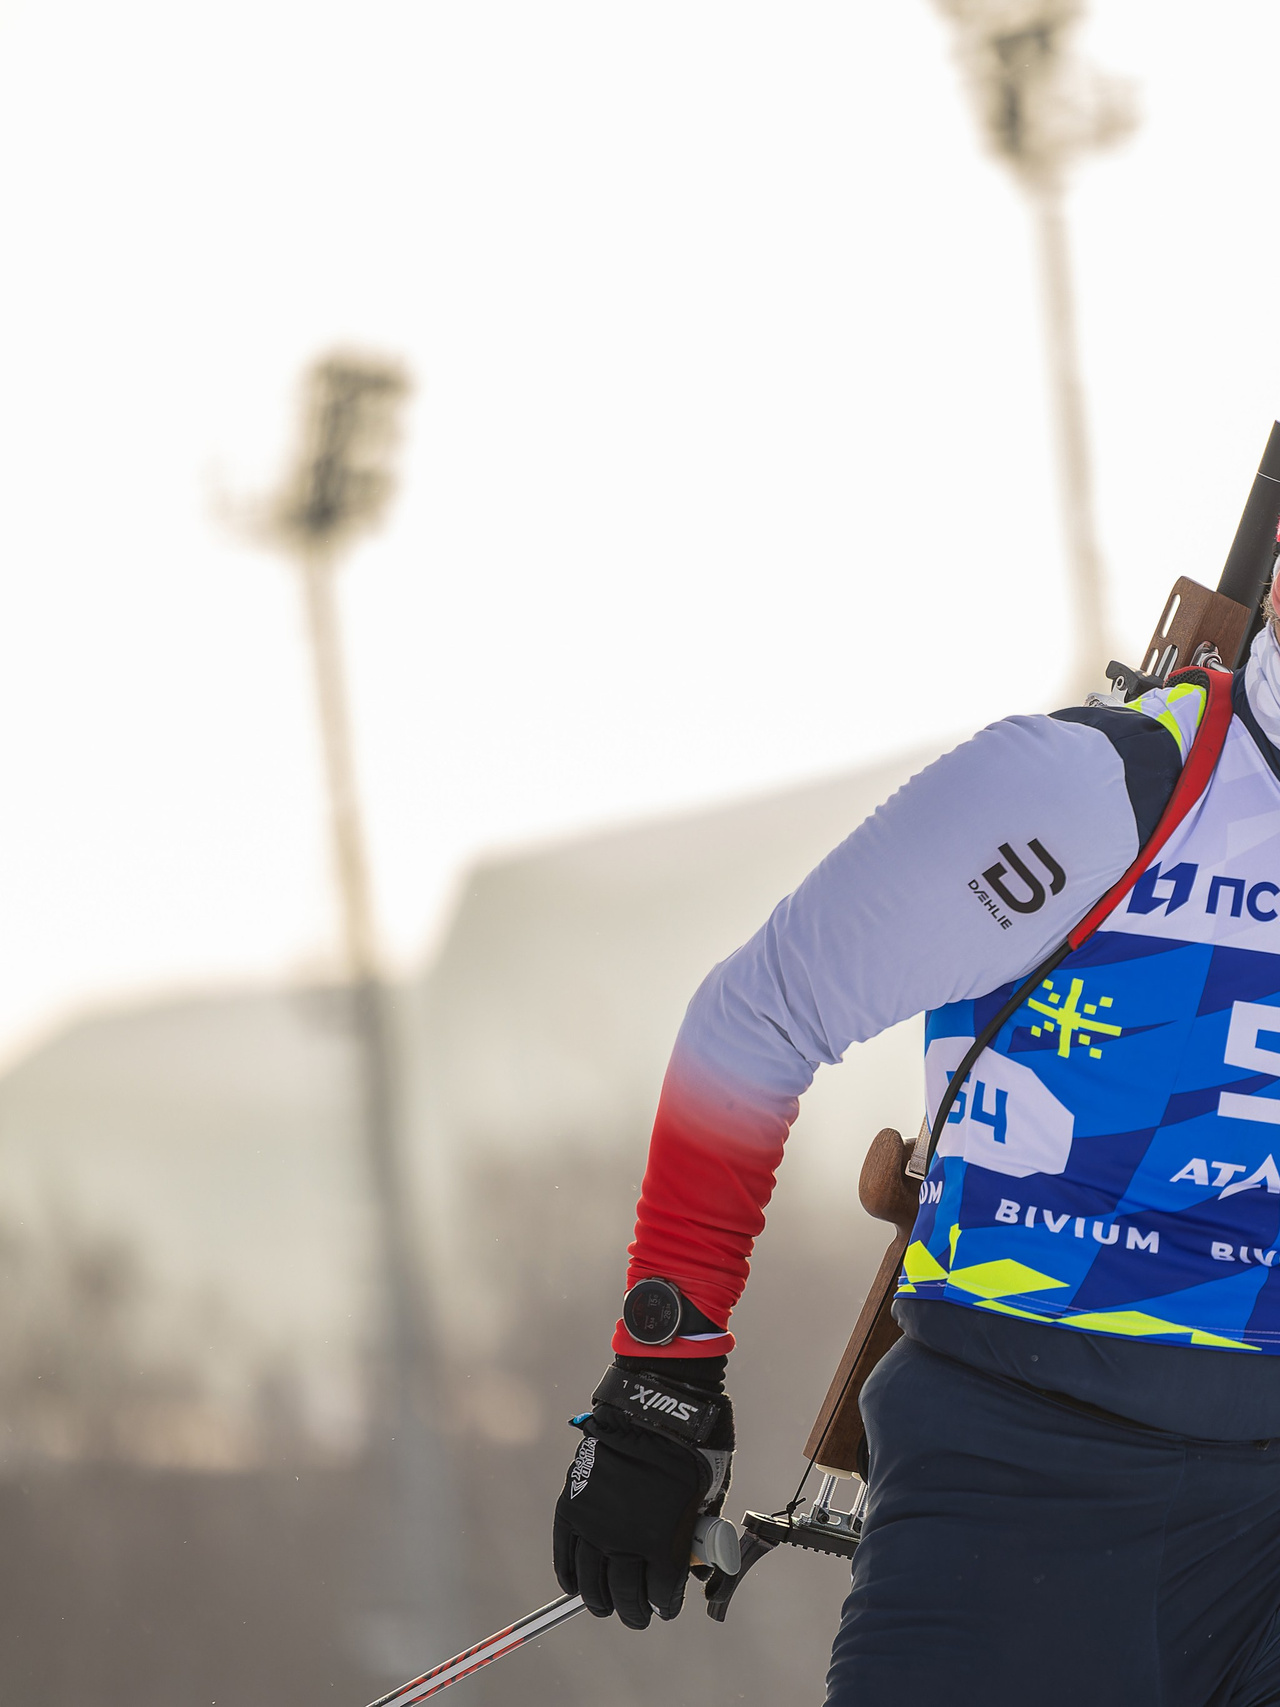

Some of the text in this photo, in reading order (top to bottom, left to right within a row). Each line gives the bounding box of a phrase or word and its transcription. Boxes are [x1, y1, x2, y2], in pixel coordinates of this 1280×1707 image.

[967, 879, 1013, 930] DÆHLIE
[946, 1070, 1009, 1145] 54
[994, 1198, 1160, 1254] BIVIUM
[571, 1440, 589, 1481] LOCK
[581, 1437, 599, 1479] WIND
